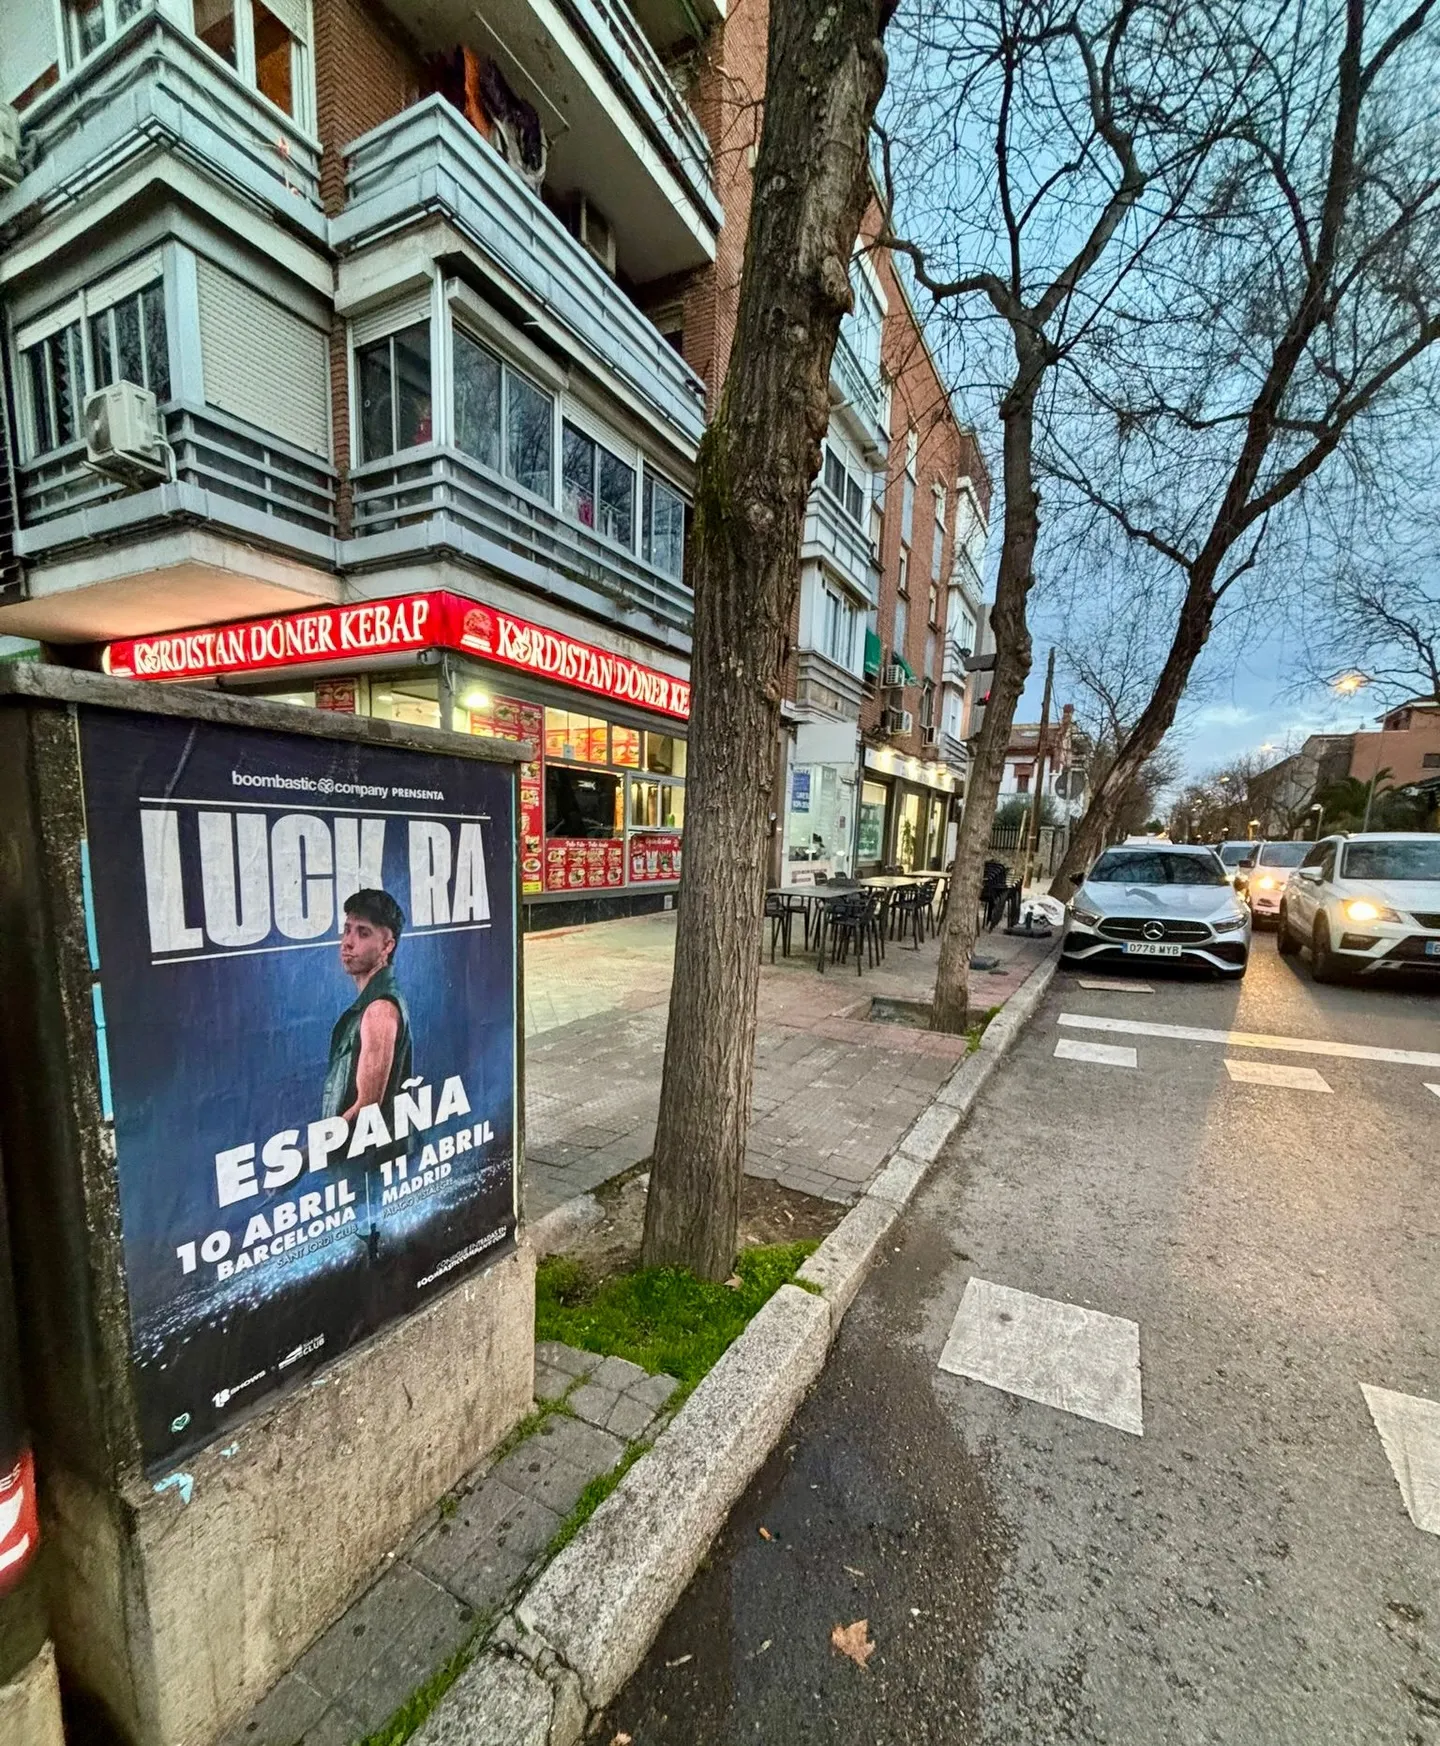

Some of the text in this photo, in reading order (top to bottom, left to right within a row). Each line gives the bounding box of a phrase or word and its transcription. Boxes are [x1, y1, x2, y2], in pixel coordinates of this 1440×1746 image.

[251, 615, 336, 661] DÖNER
[340, 600, 429, 649] KEBAP
[614, 660, 668, 709] DÖNER
[231, 770, 444, 801] boombastic company PRENSENTA
[140, 809, 491, 953] LUCK RA
[214, 1074, 471, 1208] ESPAÑA
[380, 1120, 494, 1187] 11 ABRIL
[382, 1163, 452, 1206] MADRID
[176, 1178, 356, 1275] 10 ABRIL
[217, 1206, 357, 1281] BARCELONA
[334, 1224, 358, 1242] CLUB
[303, 1337, 325, 1356] CLUB
